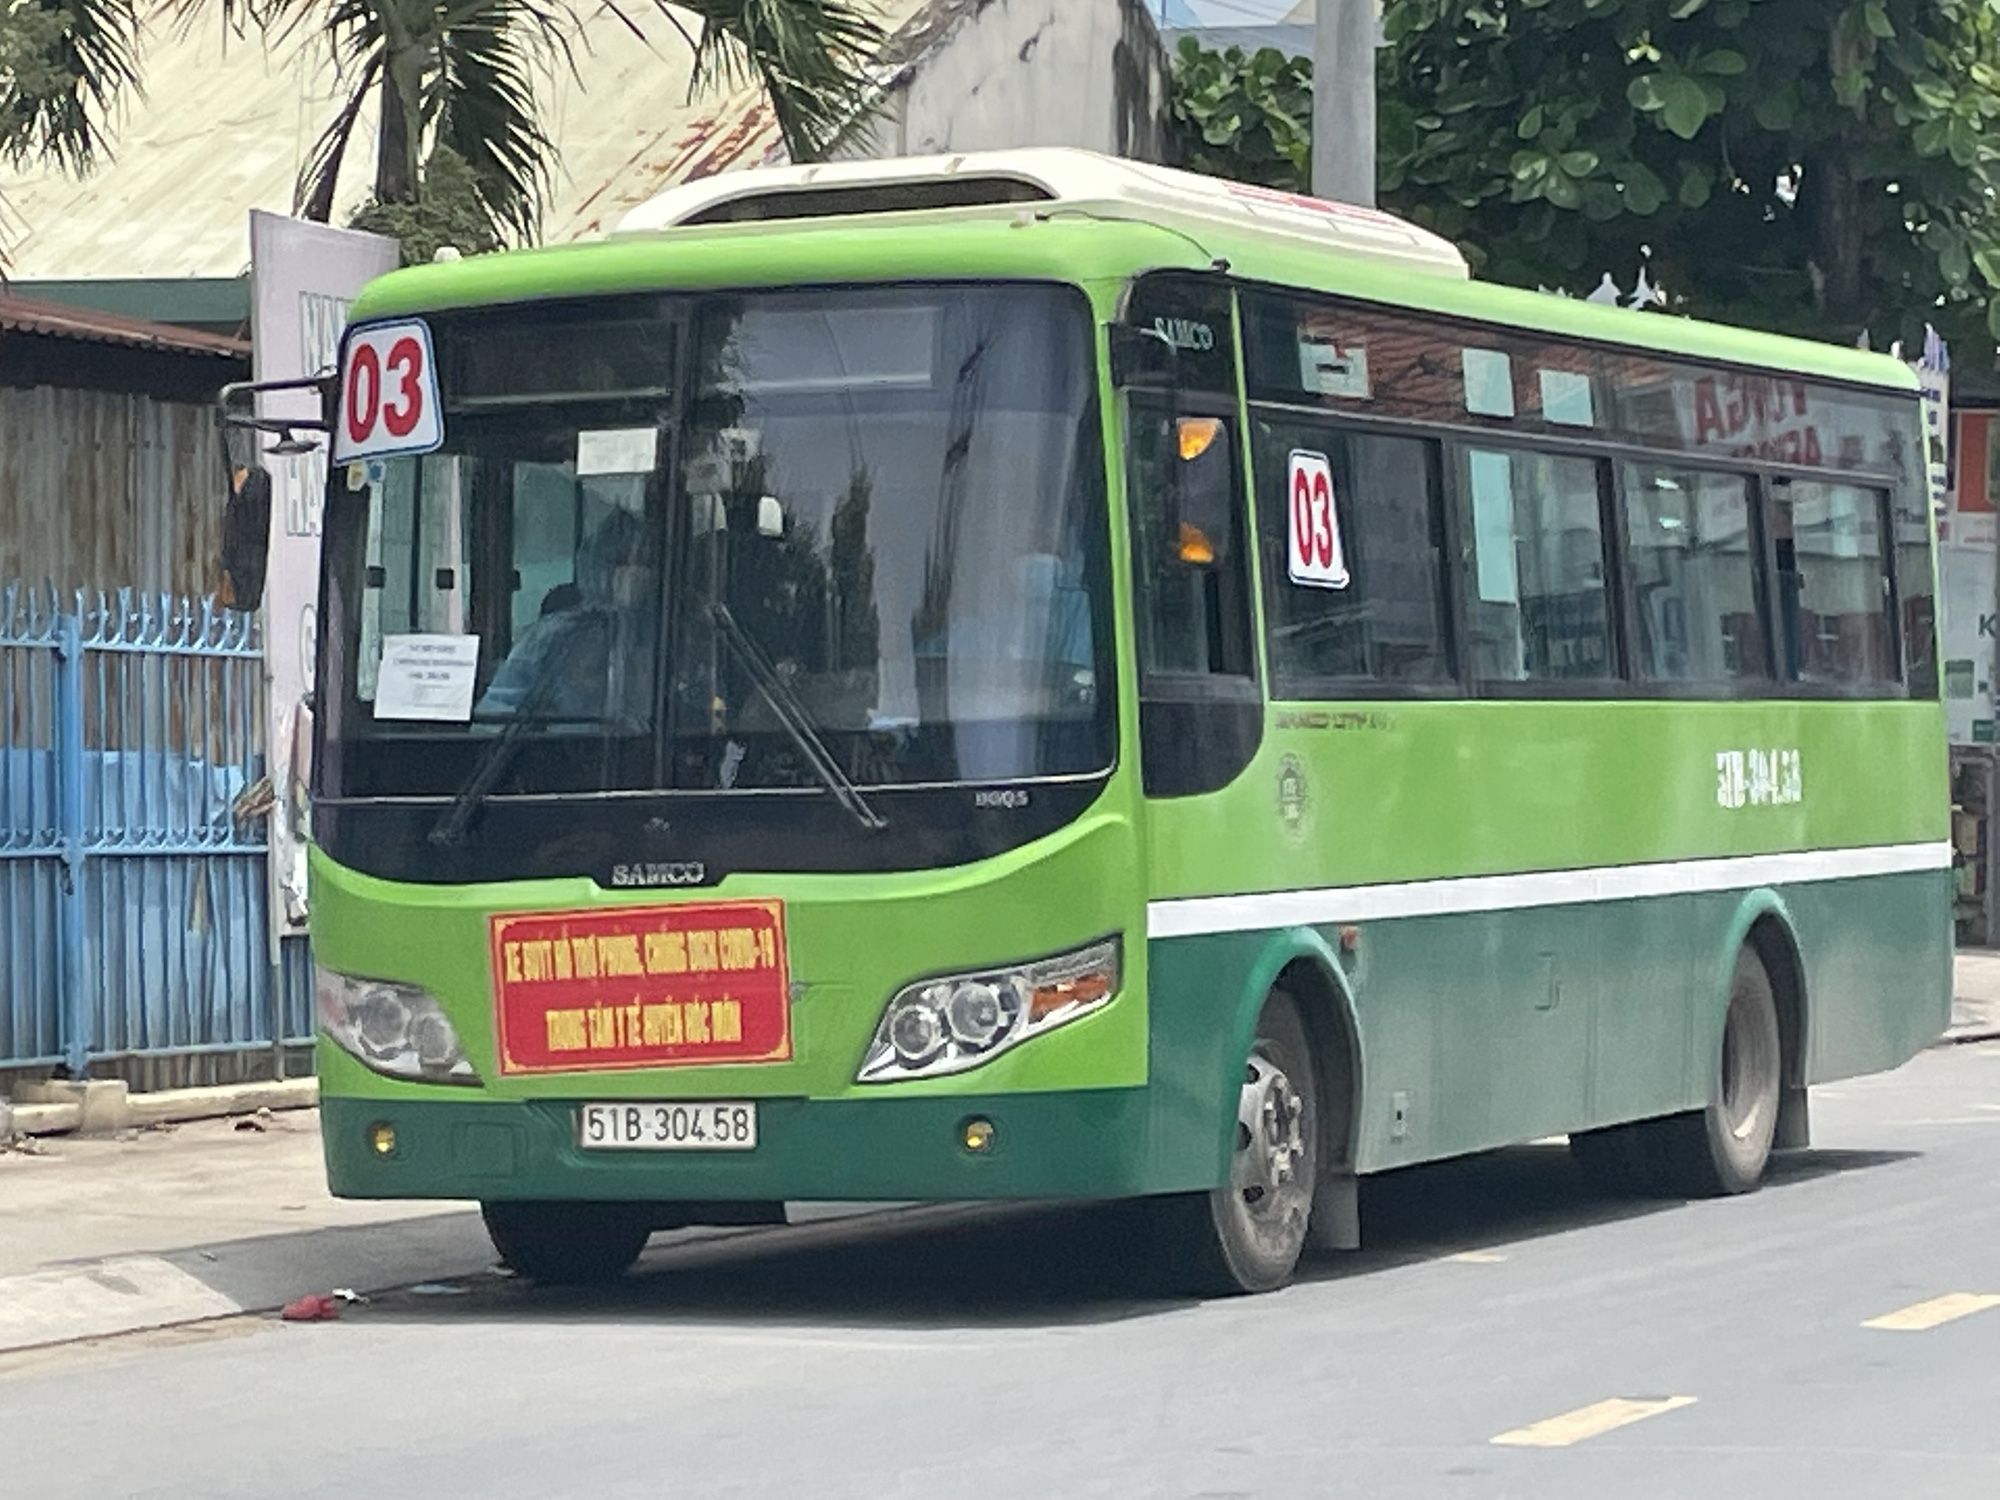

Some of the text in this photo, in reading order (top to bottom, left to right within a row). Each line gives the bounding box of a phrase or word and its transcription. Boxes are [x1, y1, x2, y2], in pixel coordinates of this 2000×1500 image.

[346, 336, 423, 444] 03
[1294, 467, 1333, 568] 03
[611, 861, 705, 886] SAMCO
[588, 1107, 749, 1142] 51B-304.58
